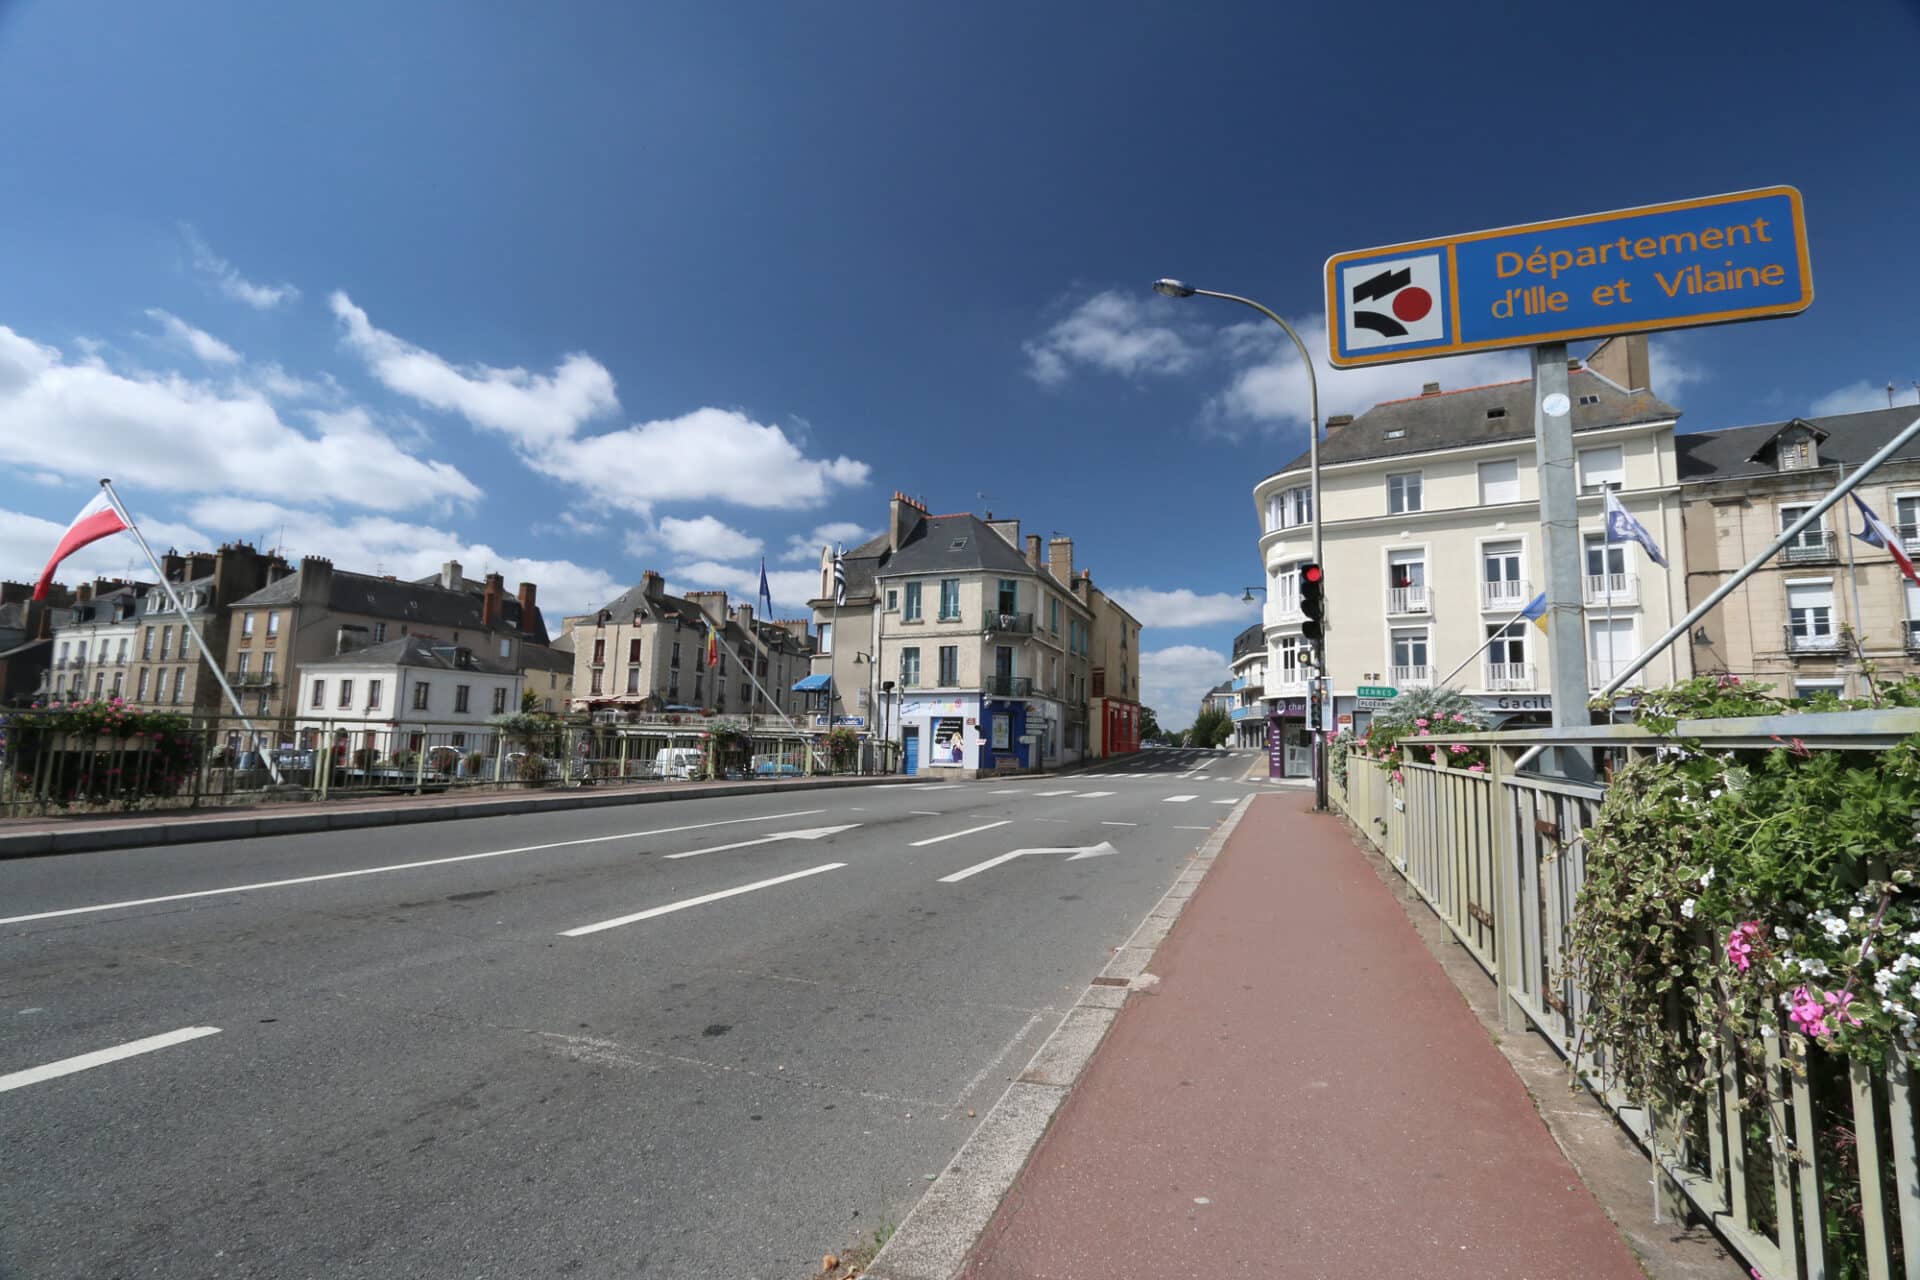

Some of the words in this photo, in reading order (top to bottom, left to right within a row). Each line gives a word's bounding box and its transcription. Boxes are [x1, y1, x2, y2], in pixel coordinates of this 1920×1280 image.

[1496, 217, 1772, 279] Département
[1491, 285, 1569, 319] d'Ille
[1592, 278, 1633, 306] et
[1654, 260, 1785, 298] Vilaine
[1359, 687, 1392, 696] RENNES
